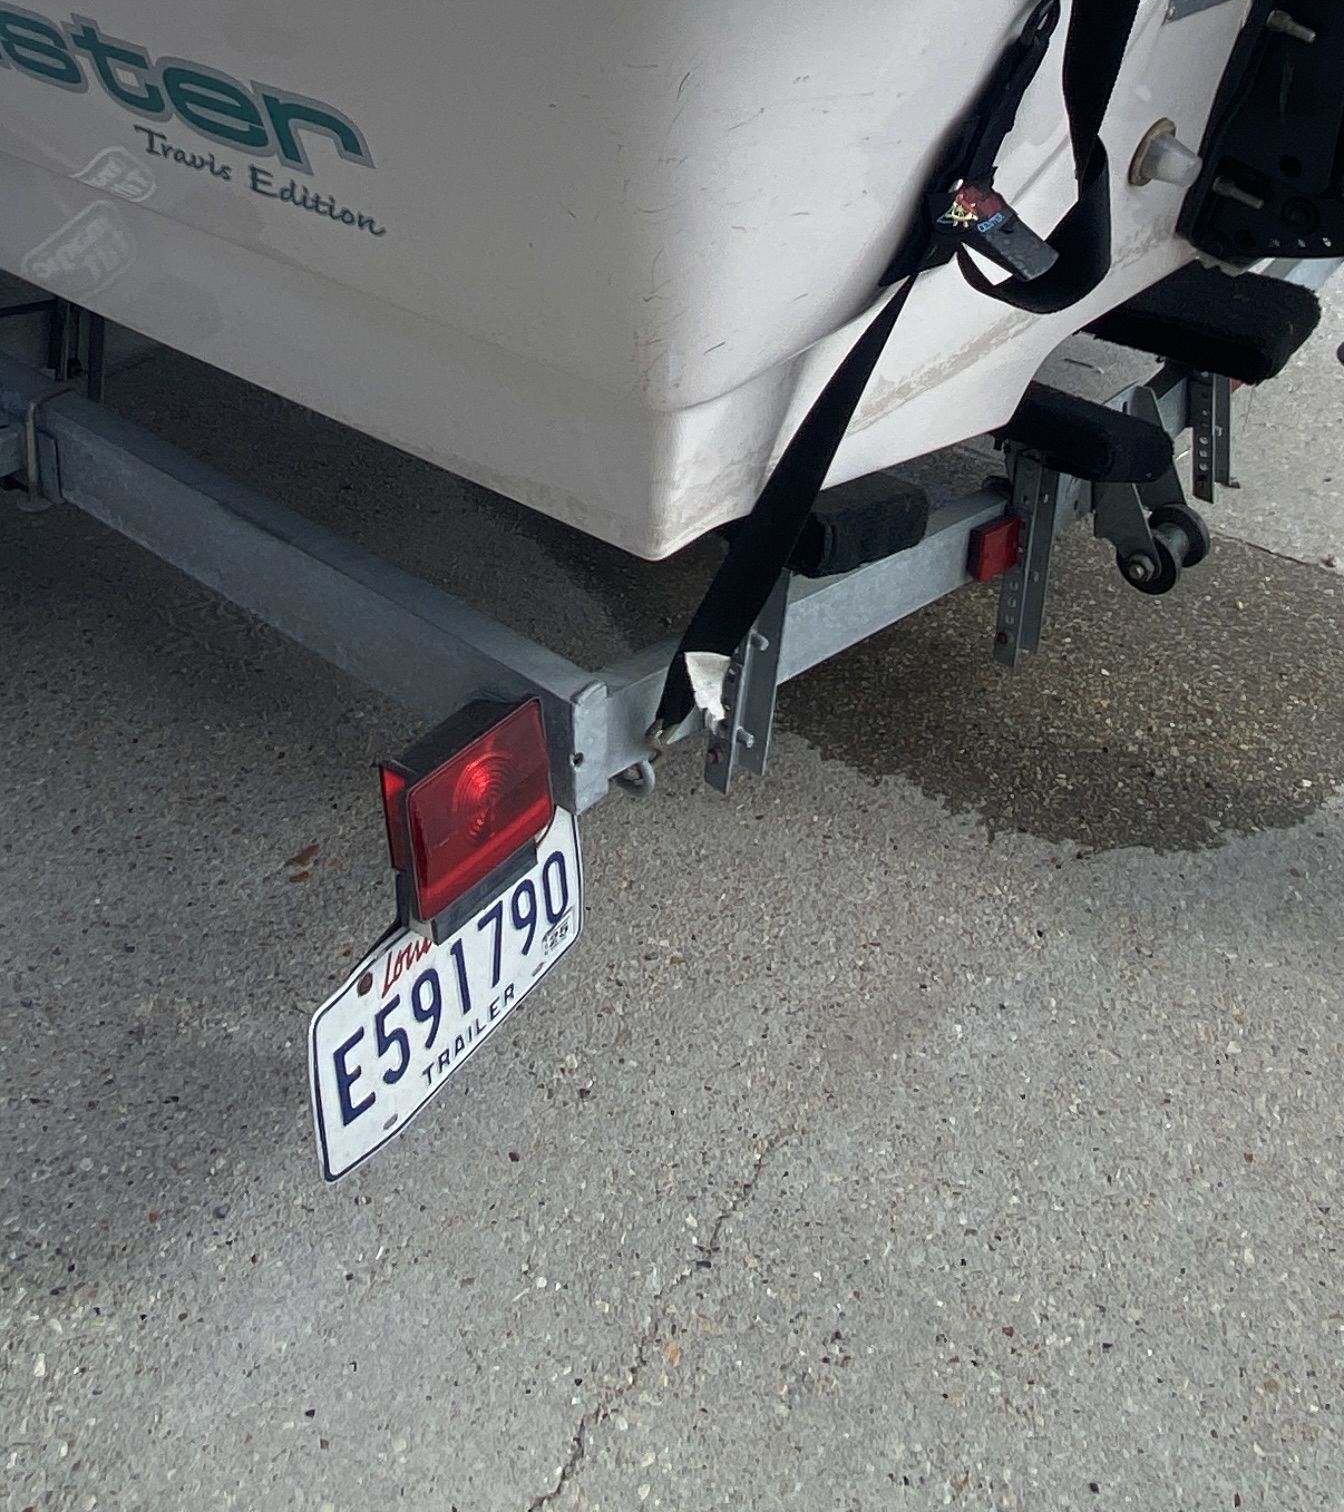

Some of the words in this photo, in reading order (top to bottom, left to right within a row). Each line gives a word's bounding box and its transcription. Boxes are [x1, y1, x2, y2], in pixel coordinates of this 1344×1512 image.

[133, 124, 233, 183] Travis
[248, 164, 387, 239] Edition
[332, 850, 571, 1127] E591790
[421, 982, 517, 1086] TRAILER
